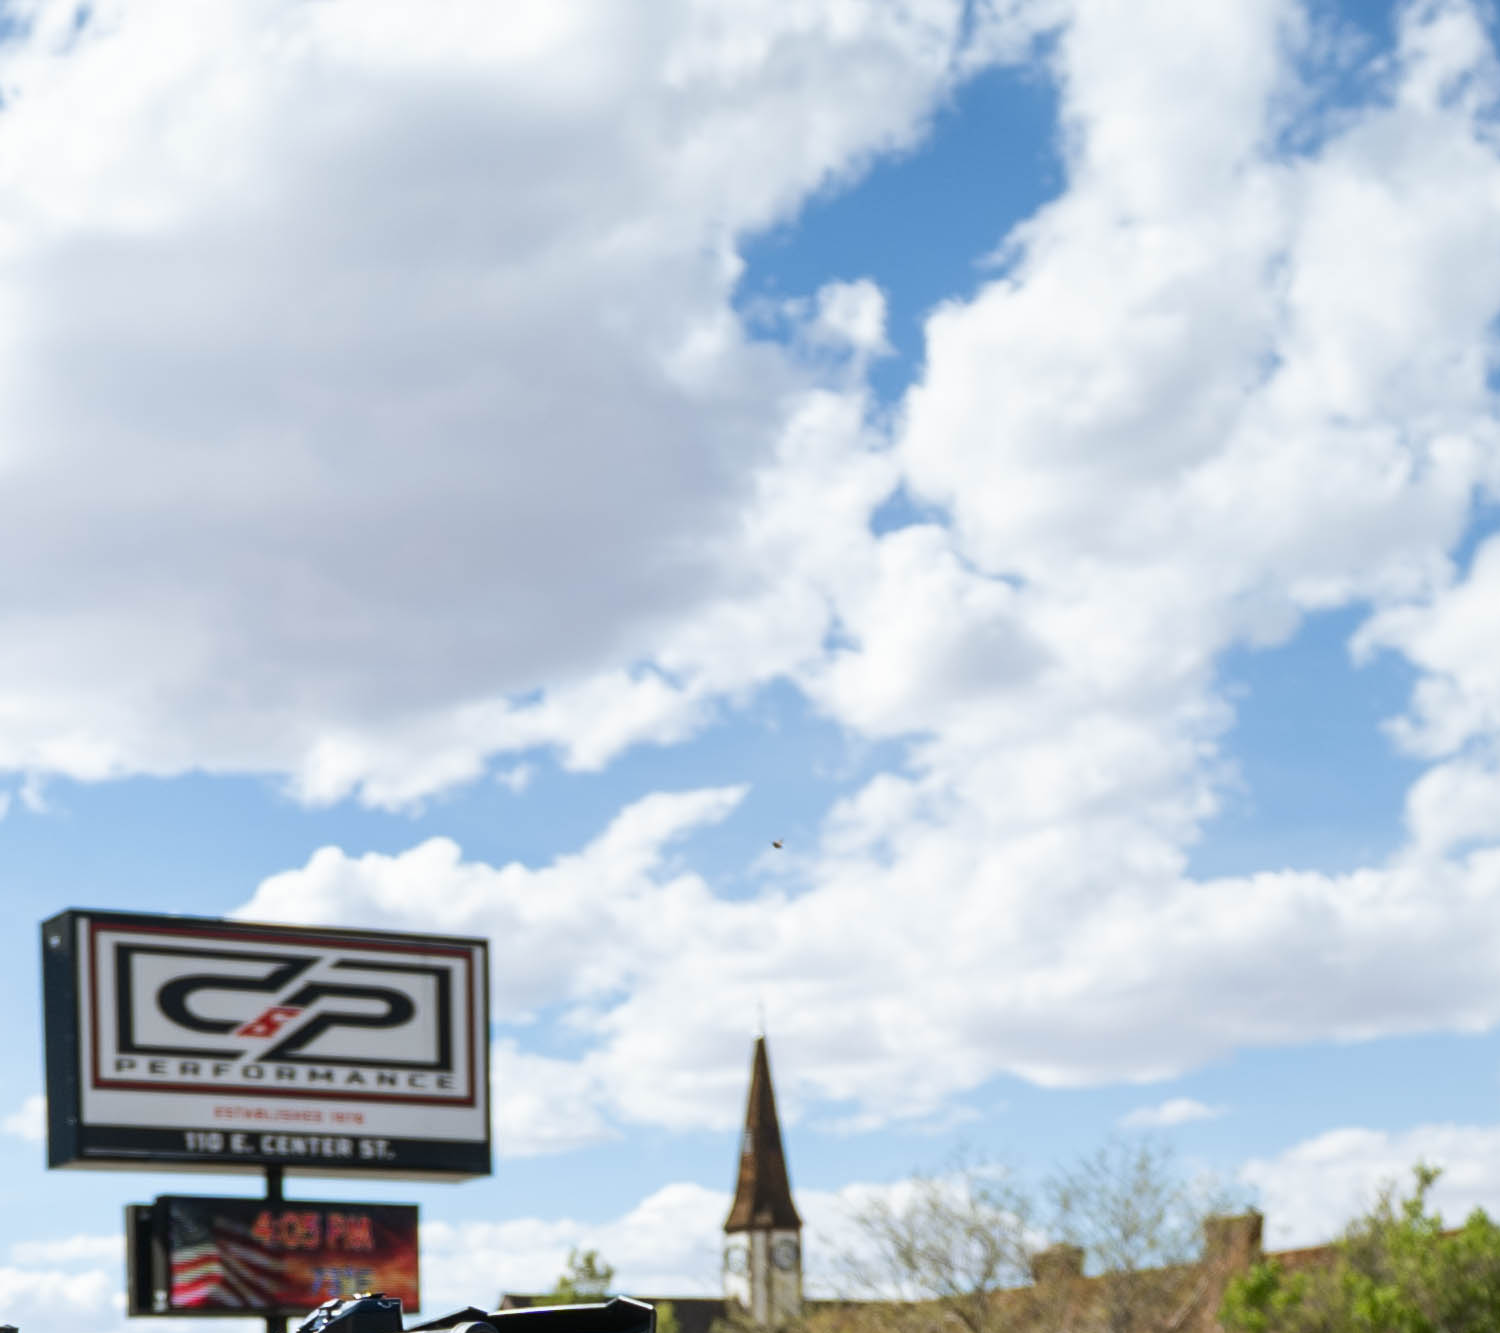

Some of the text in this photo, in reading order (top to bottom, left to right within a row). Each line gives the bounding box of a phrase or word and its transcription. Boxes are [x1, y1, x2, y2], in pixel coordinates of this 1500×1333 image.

[115, 1059, 457, 1090] PERFORMANCE
[185, 1131, 397, 1160] 110 E. CENTER ST.
